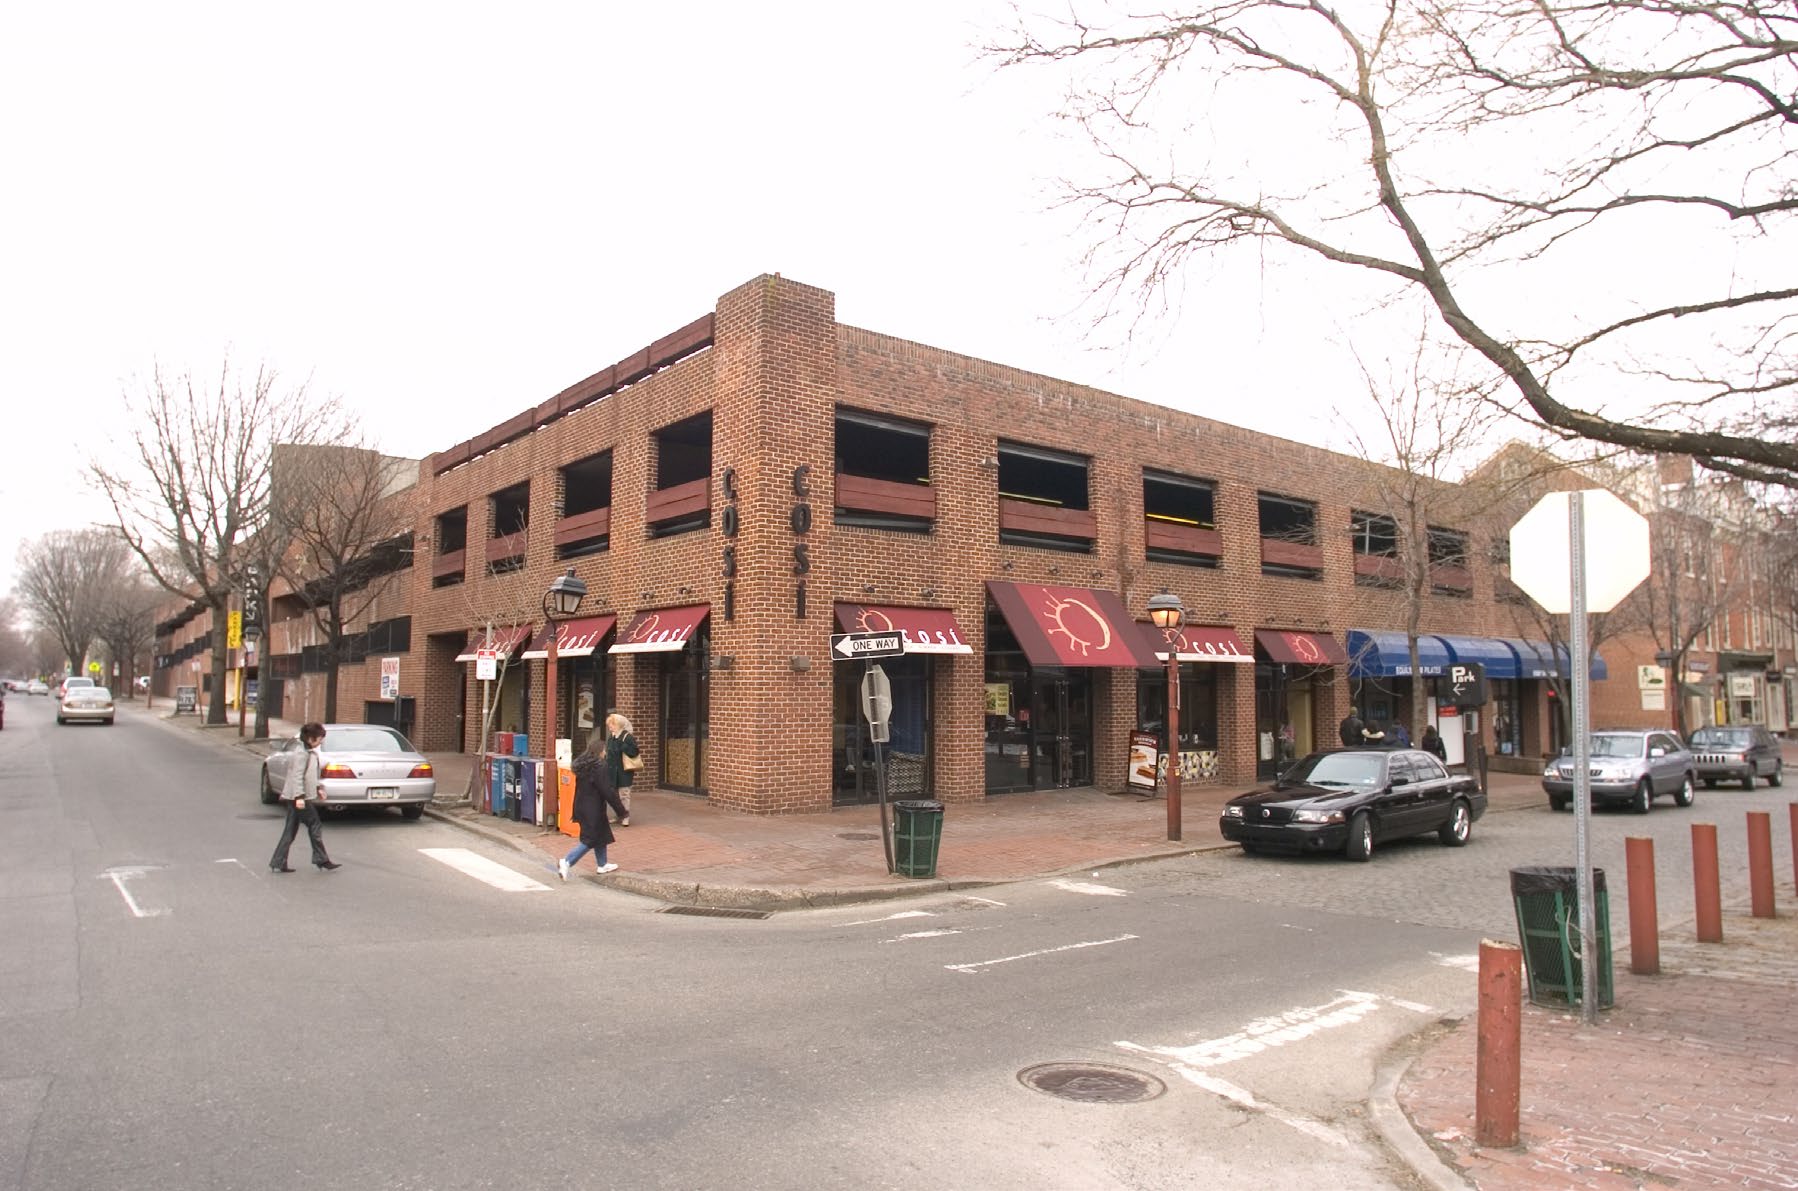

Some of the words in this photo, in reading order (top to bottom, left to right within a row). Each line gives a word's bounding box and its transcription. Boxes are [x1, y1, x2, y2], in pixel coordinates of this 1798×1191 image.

[853, 640, 872, 651] ONE
[875, 638, 896, 649] WAY
[1452, 667, 1475, 683] Park
